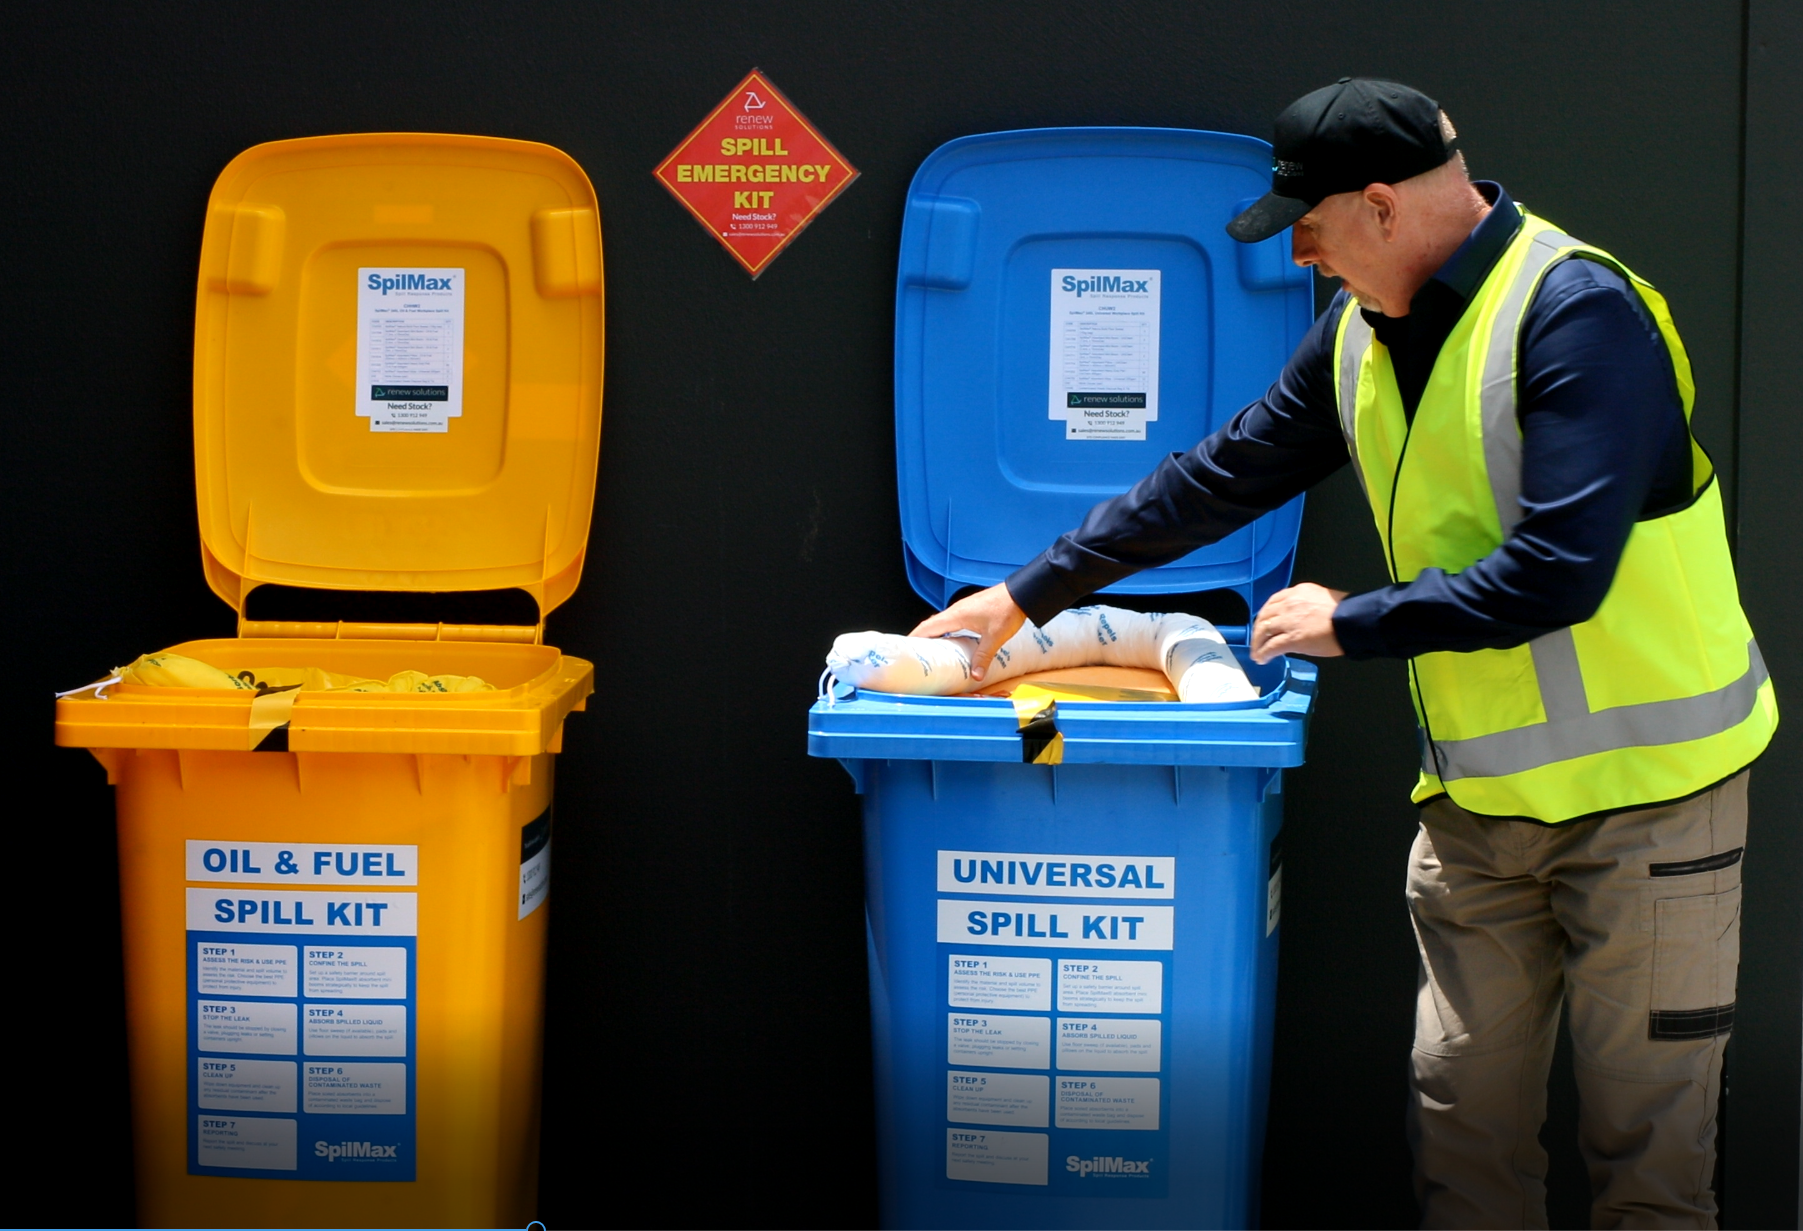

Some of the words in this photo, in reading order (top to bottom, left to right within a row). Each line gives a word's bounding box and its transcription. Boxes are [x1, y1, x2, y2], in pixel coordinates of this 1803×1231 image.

[736, 115, 773, 123] renew
[721, 138, 788, 155] SPILL
[677, 165, 831, 182] EMERGENCY
[734, 192, 774, 208] KIT
[368, 274, 452, 295] SpilMax
[1062, 276, 1148, 297] SpilMax
[1109, 395, 1143, 403] solutions
[203, 848, 261, 873] OIL
[274, 850, 299, 874] &
[314, 852, 405, 876] FUEL
[953, 859, 1164, 889] UNIVERSAL
[214, 899, 314, 925] SPILL
[327, 902, 388, 926] KIT
[967, 911, 1068, 938] SPILL
[1083, 916, 1144, 940] KIT
[954, 960, 979, 968] STEP
[203, 1005, 227, 1013] STEP
[309, 1009, 334, 1017] STEP
[954, 1018, 978, 1026] STEP
[203, 1063, 227, 1071] STEP
[309, 1067, 334, 1075] STEP
[953, 1076, 977, 1084] STEP
[203, 1120, 227, 1128] STEP
[952, 1134, 977, 1142] STEP
[315, 1141, 397, 1162] SpilMax
[1066, 1156, 1149, 1177] SpilMax
